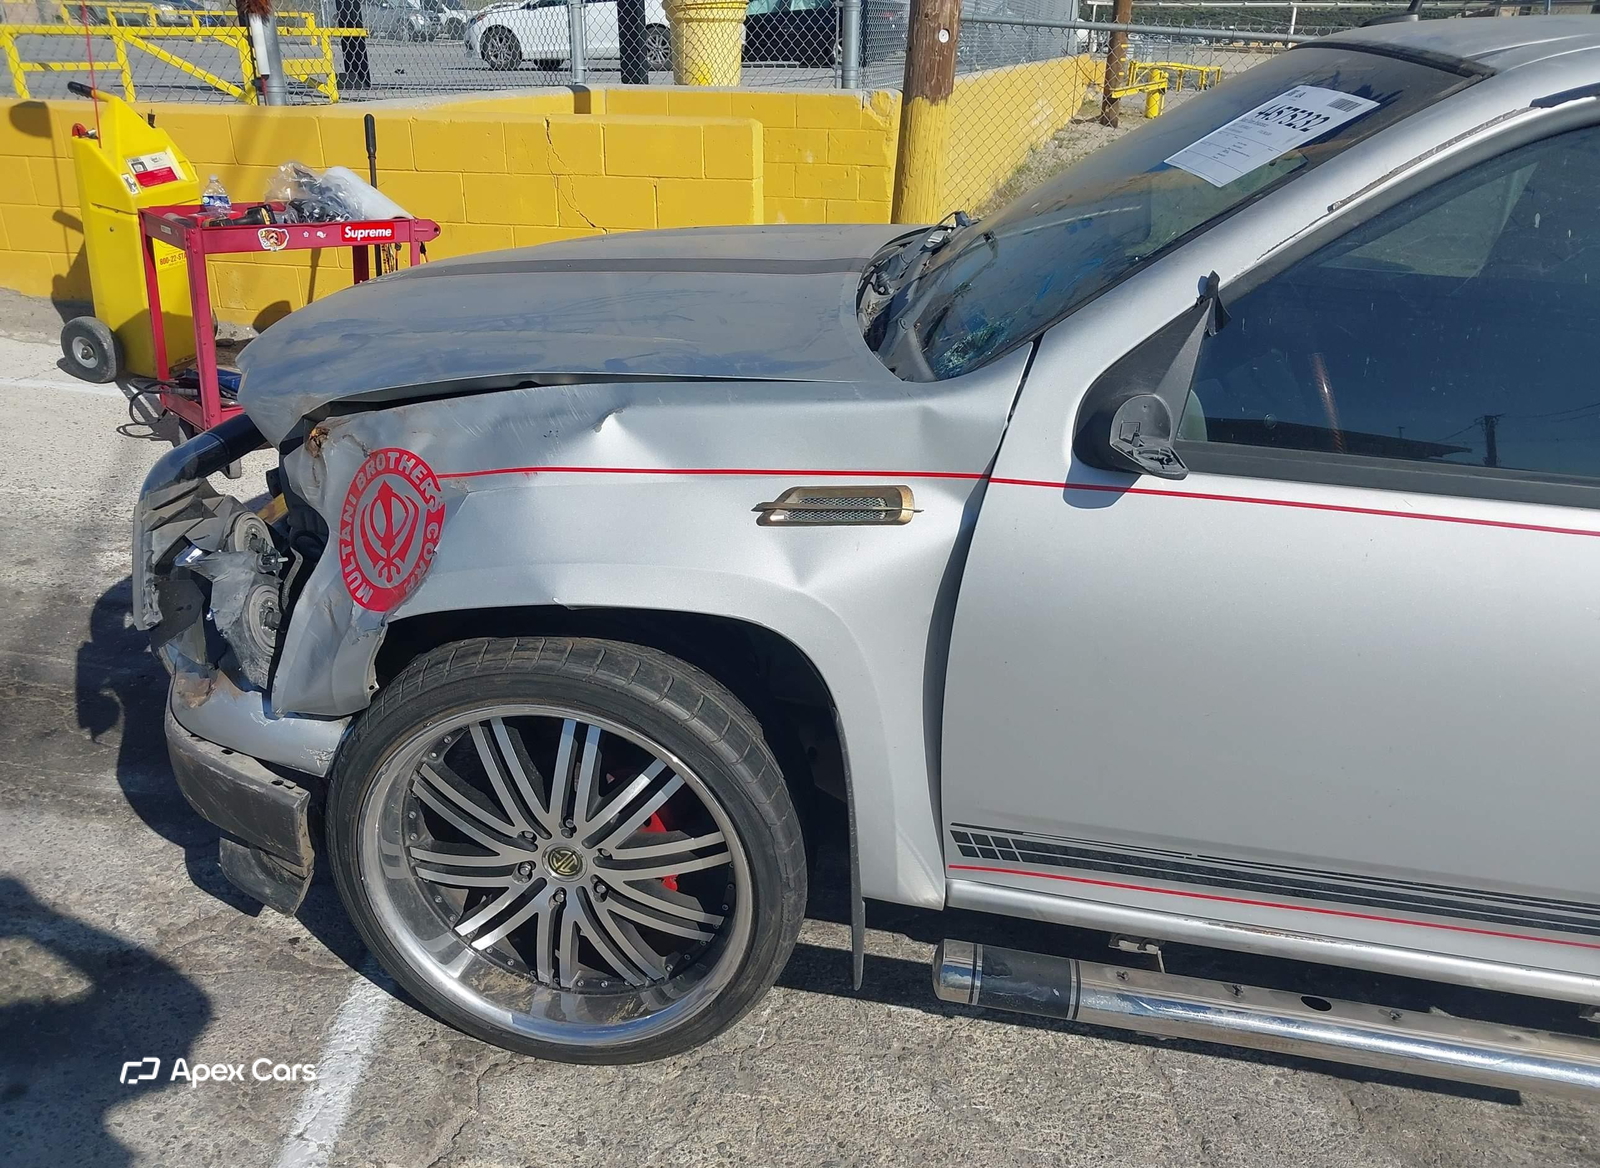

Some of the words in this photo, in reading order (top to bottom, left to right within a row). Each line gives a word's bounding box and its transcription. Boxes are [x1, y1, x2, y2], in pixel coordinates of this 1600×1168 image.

[1254, 104, 1331, 132] 44575232
[344, 226, 392, 241] Supreme
[356, 452, 443, 513] BROTHERS
[340, 493, 375, 604] MULTANI
